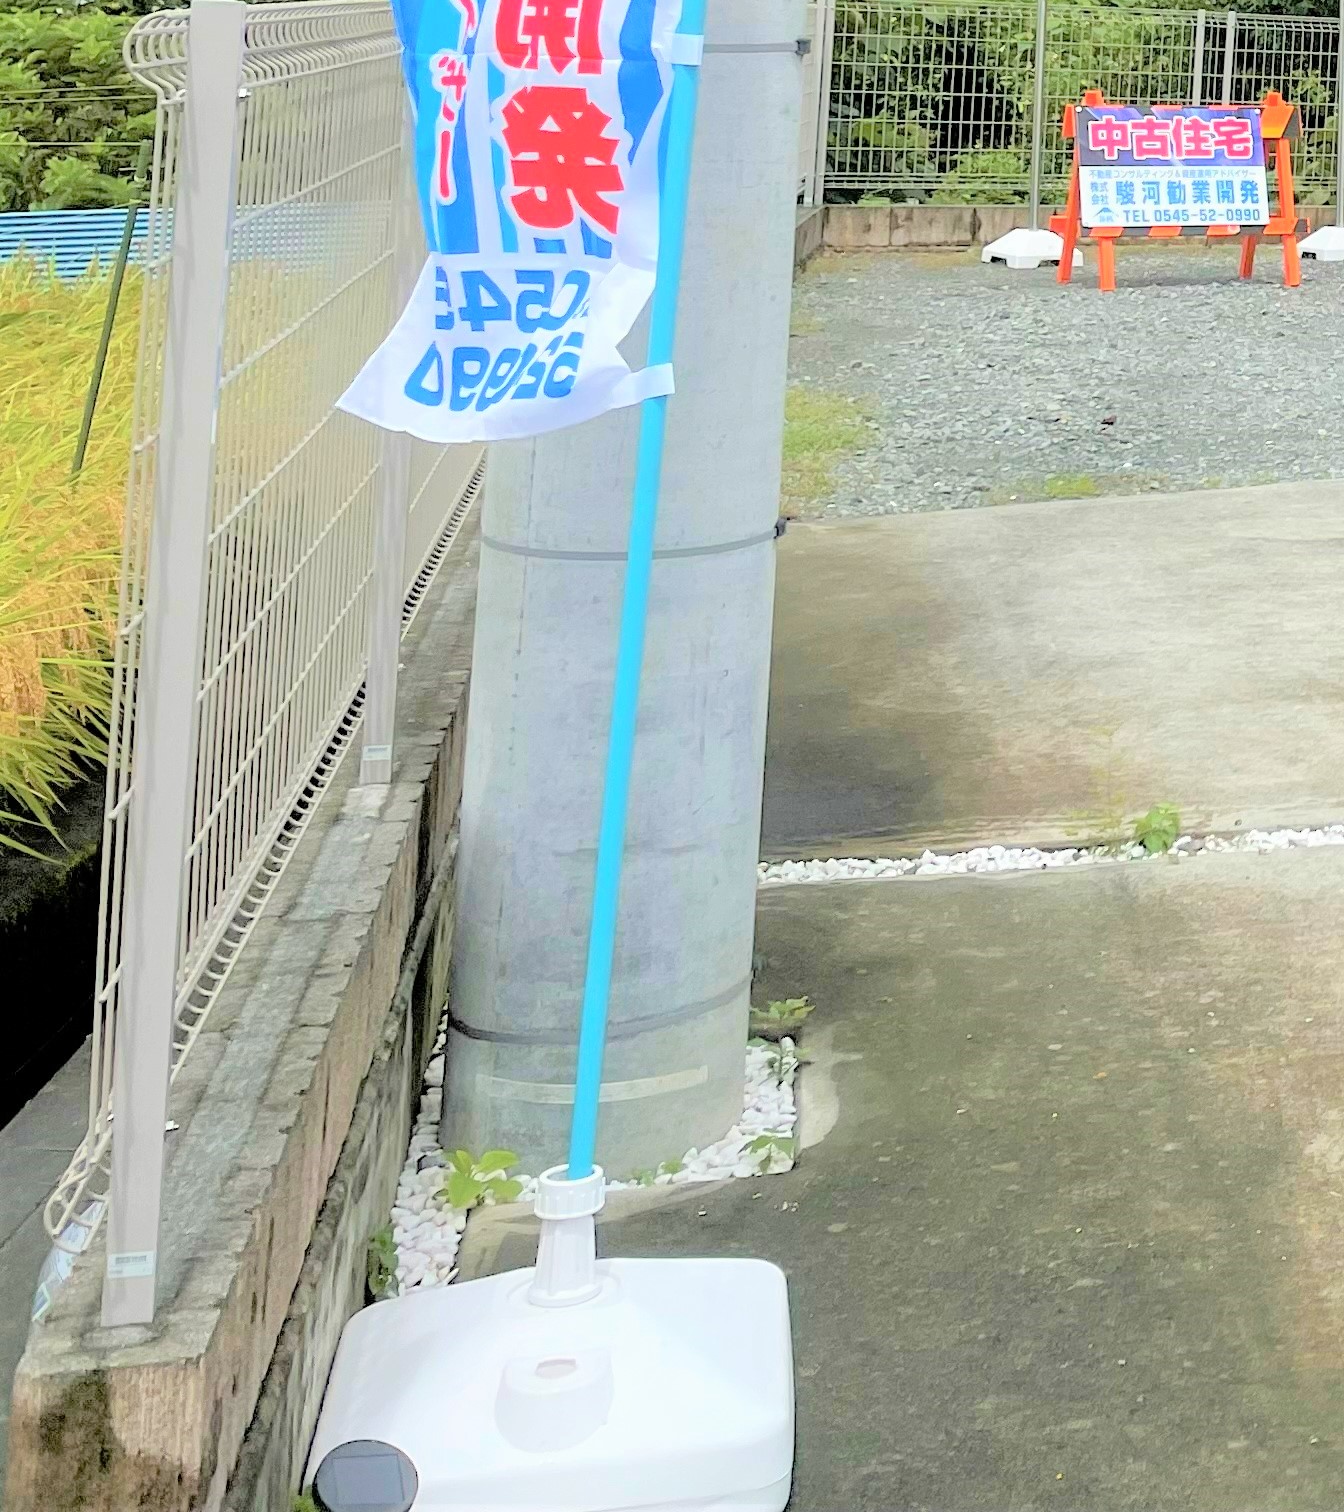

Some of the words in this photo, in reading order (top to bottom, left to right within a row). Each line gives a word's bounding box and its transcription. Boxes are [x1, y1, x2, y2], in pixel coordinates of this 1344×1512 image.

[1089, 117, 1252, 159] 中古住宅
[1123, 209, 1150, 222] TEL
[1154, 208, 1260, 222] 0545-52-0990
